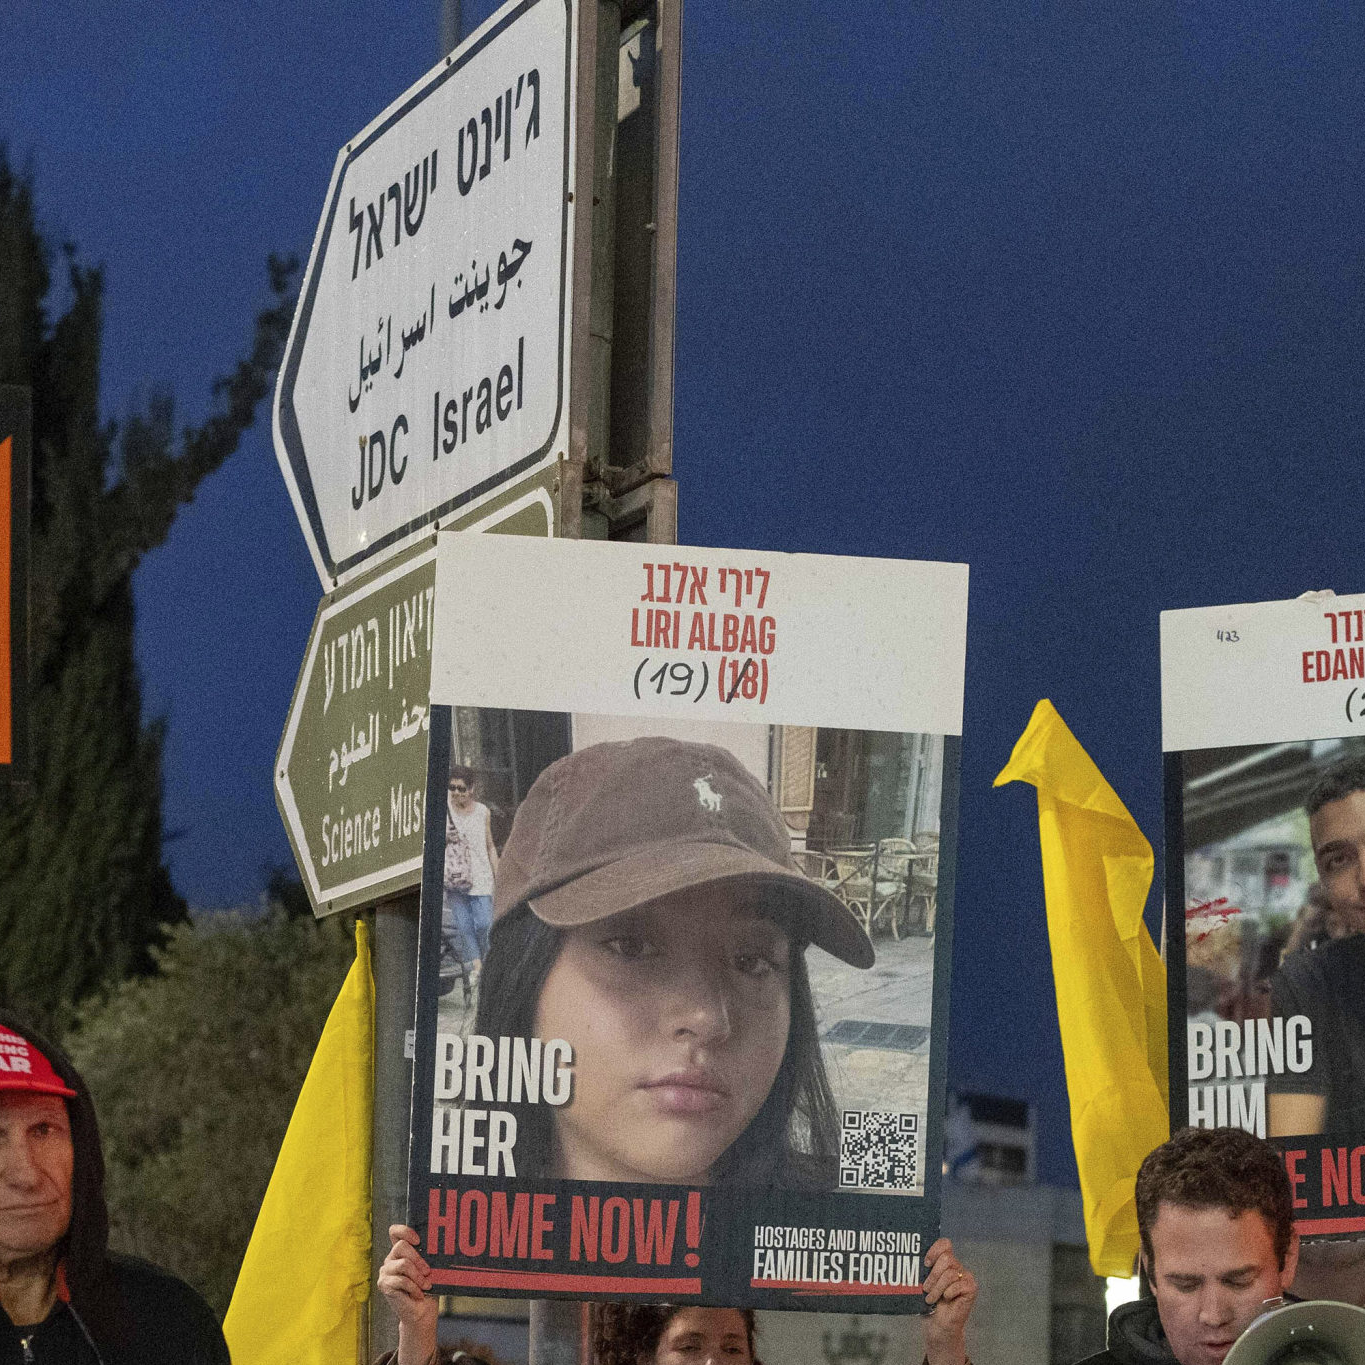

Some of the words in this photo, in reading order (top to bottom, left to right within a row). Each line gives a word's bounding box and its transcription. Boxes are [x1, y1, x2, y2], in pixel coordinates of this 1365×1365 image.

[457, 68, 541, 197] ג'וינט
[348, 149, 439, 282] ישראל
[449, 238, 533, 320] جوينت
[348, 282, 436, 414] اسرائيل
[351, 413, 409, 511] JDC
[433, 336, 525, 462] Israel
[641, 562, 709, 605] אלבג
[718, 567, 771, 609] לירי
[322, 616, 381, 717] המדע
[388, 586, 434, 690] זיאון
[630, 608, 681, 649] LIRI
[687, 611, 777, 655] ALBAG
[1302, 644, 1365, 683] EDAN
[633, 657, 710, 703] (19)
[329, 711, 380, 793] العلوم
[322, 806, 381, 867] Science
[390, 783, 426, 843] Mus
[434, 1033, 573, 1106] BRING
[1188, 1015, 1313, 1080] BRING
[430, 1107, 517, 1178] HER
[1188, 1078, 1267, 1140] HIM
[426, 1187, 556, 1261] HOME
[569, 1191, 702, 1268] NOW!
[754, 1225, 825, 1250] HOSTAGES
[827, 1229, 856, 1251] AND
[859, 1230, 921, 1254] MISSING
[753, 1248, 844, 1284] FAMILIES
[848, 1253, 920, 1287] FORUM
